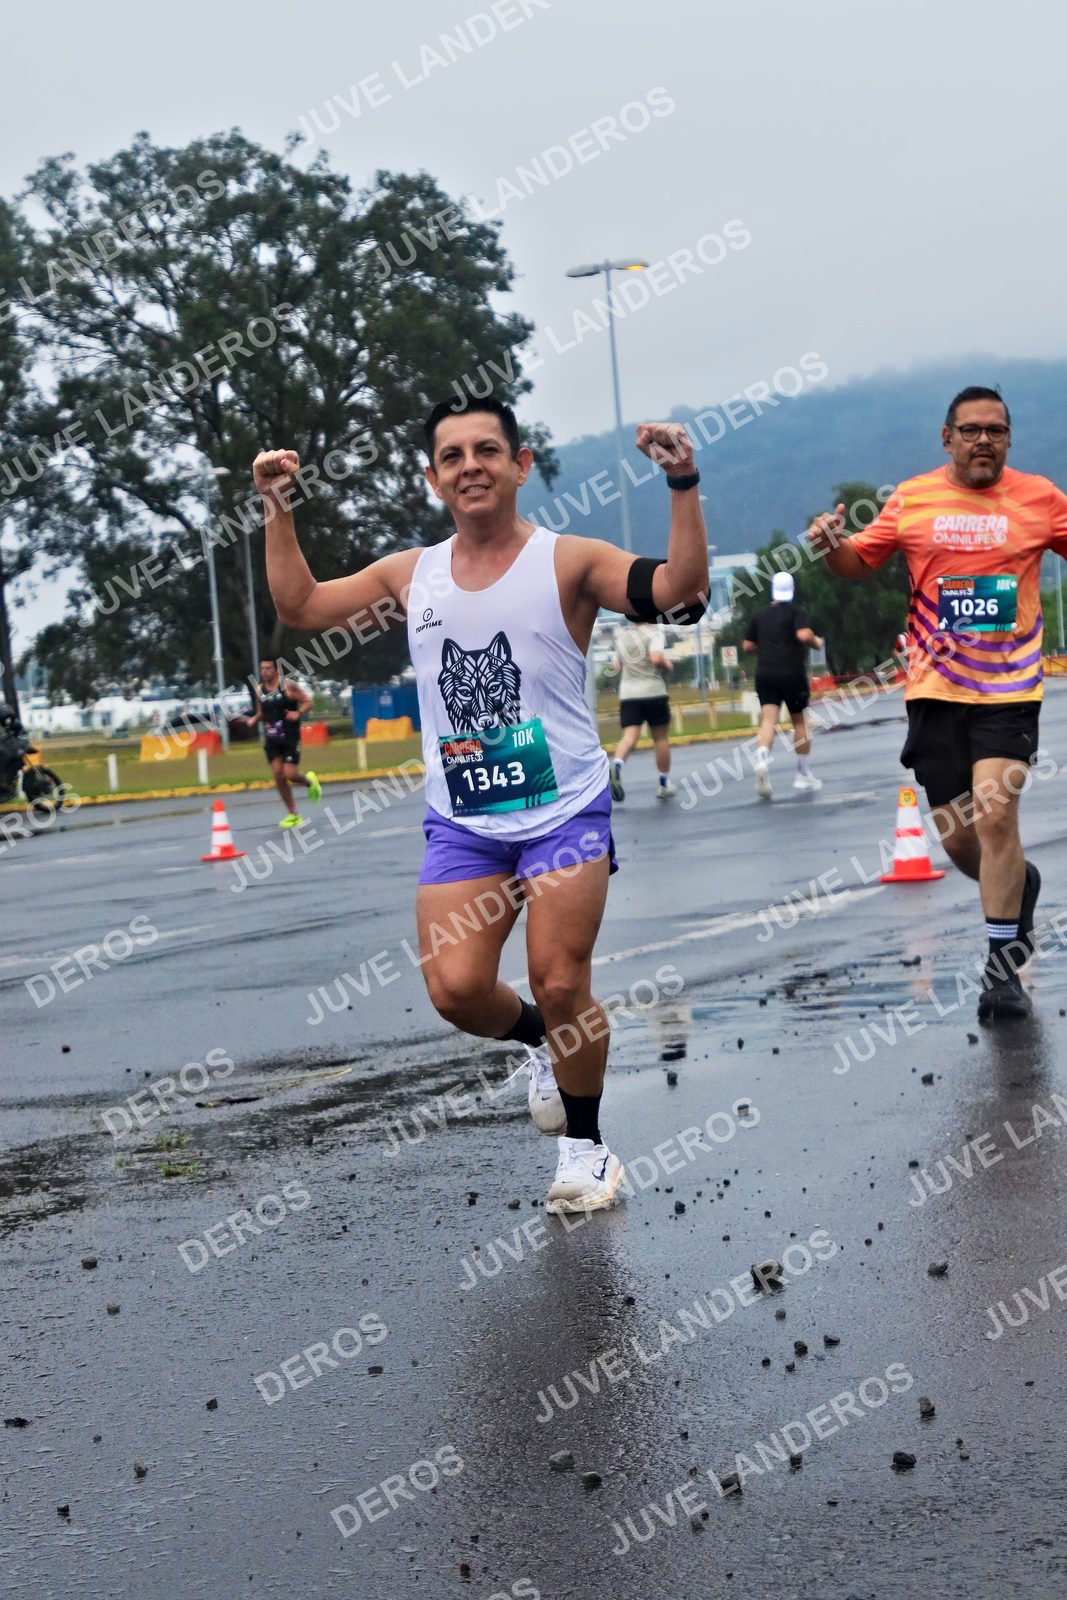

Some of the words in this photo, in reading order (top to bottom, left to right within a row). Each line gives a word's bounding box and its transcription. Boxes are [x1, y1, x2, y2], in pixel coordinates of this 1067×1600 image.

[933, 514, 1008, 532] CARRERA
[950, 598, 998, 616] 1026
[415, 619, 443, 634] TOPTIME
[512, 728, 534, 748] 10K
[462, 762, 526, 792] 1343
